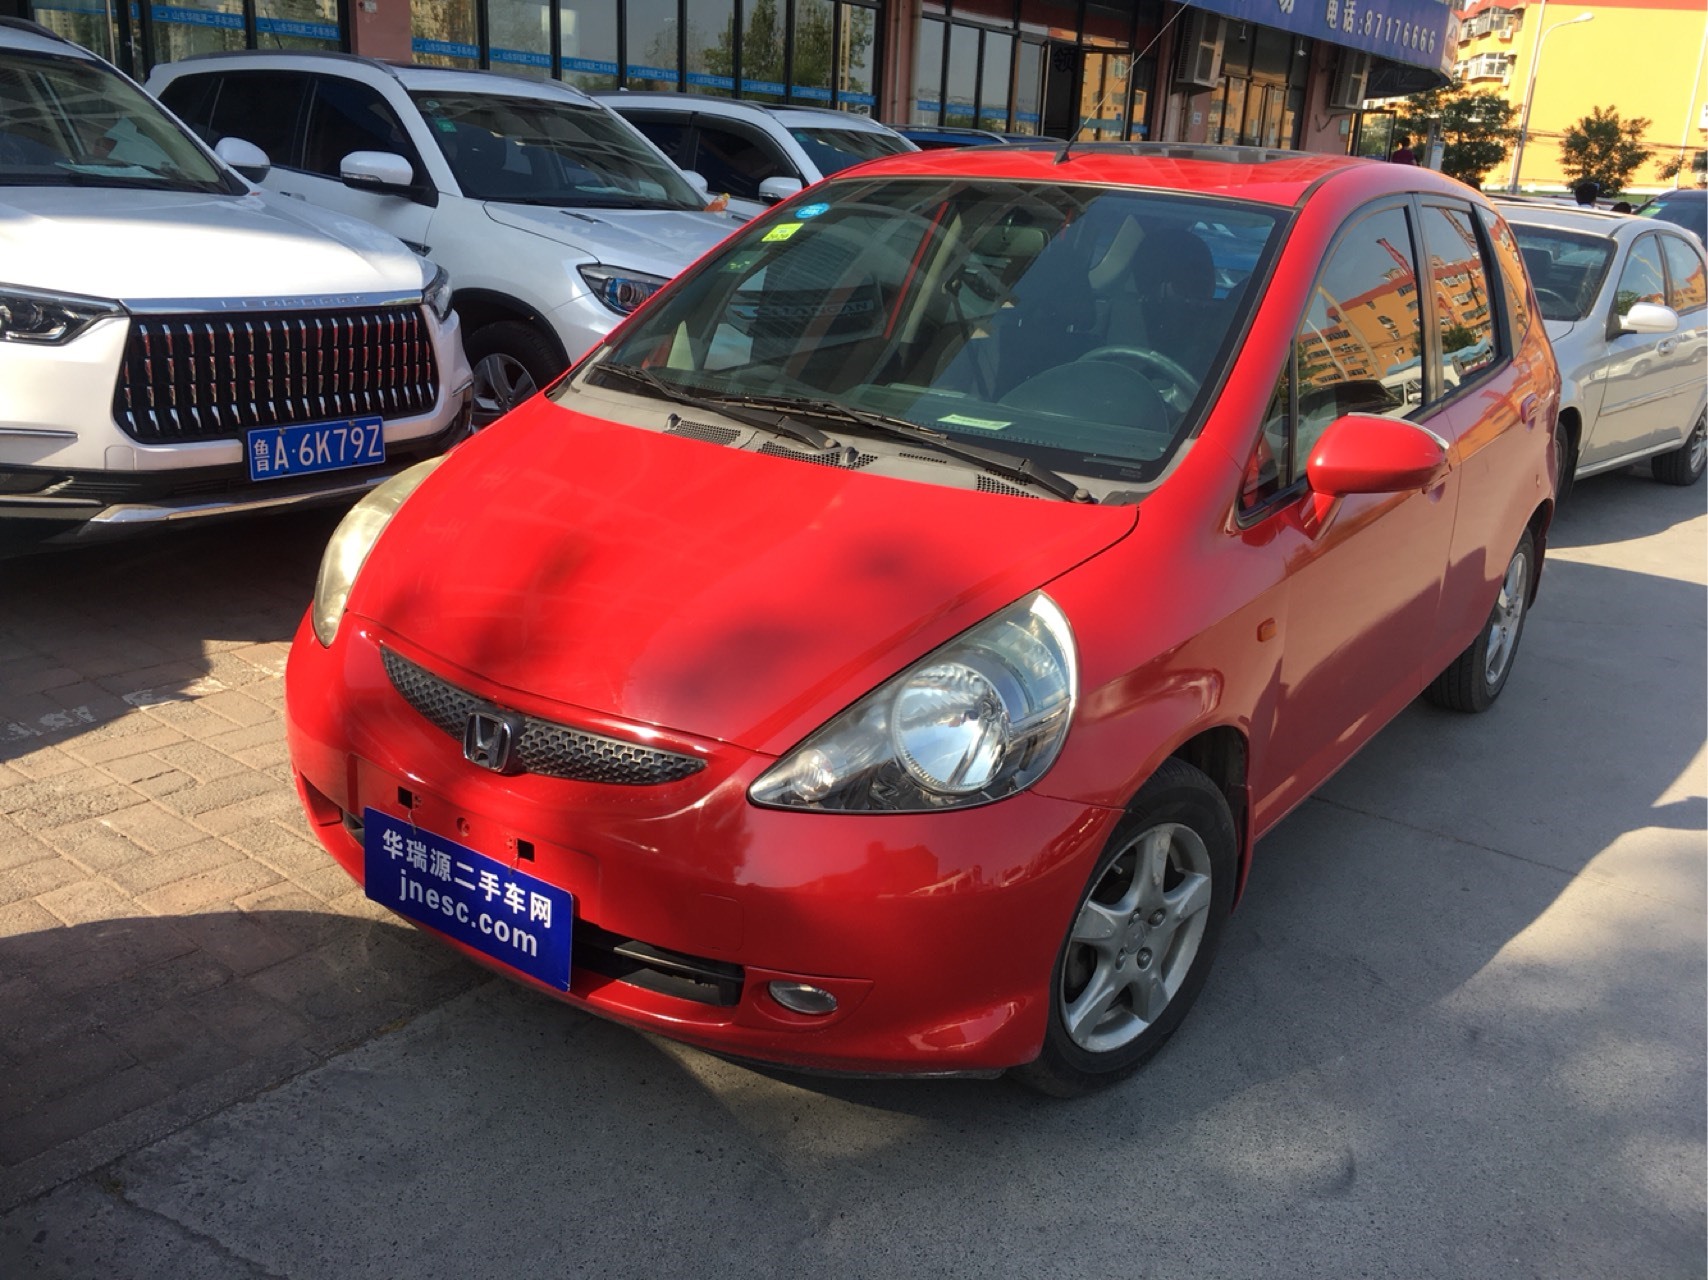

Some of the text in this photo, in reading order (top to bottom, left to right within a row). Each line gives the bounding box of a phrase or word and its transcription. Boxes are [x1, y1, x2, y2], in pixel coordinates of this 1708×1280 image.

[1326, 0, 1436, 54] 电话:87176666
[382, 828, 552, 928] 华瑞源二手车网
[399, 868, 537, 957] jnesc.com
